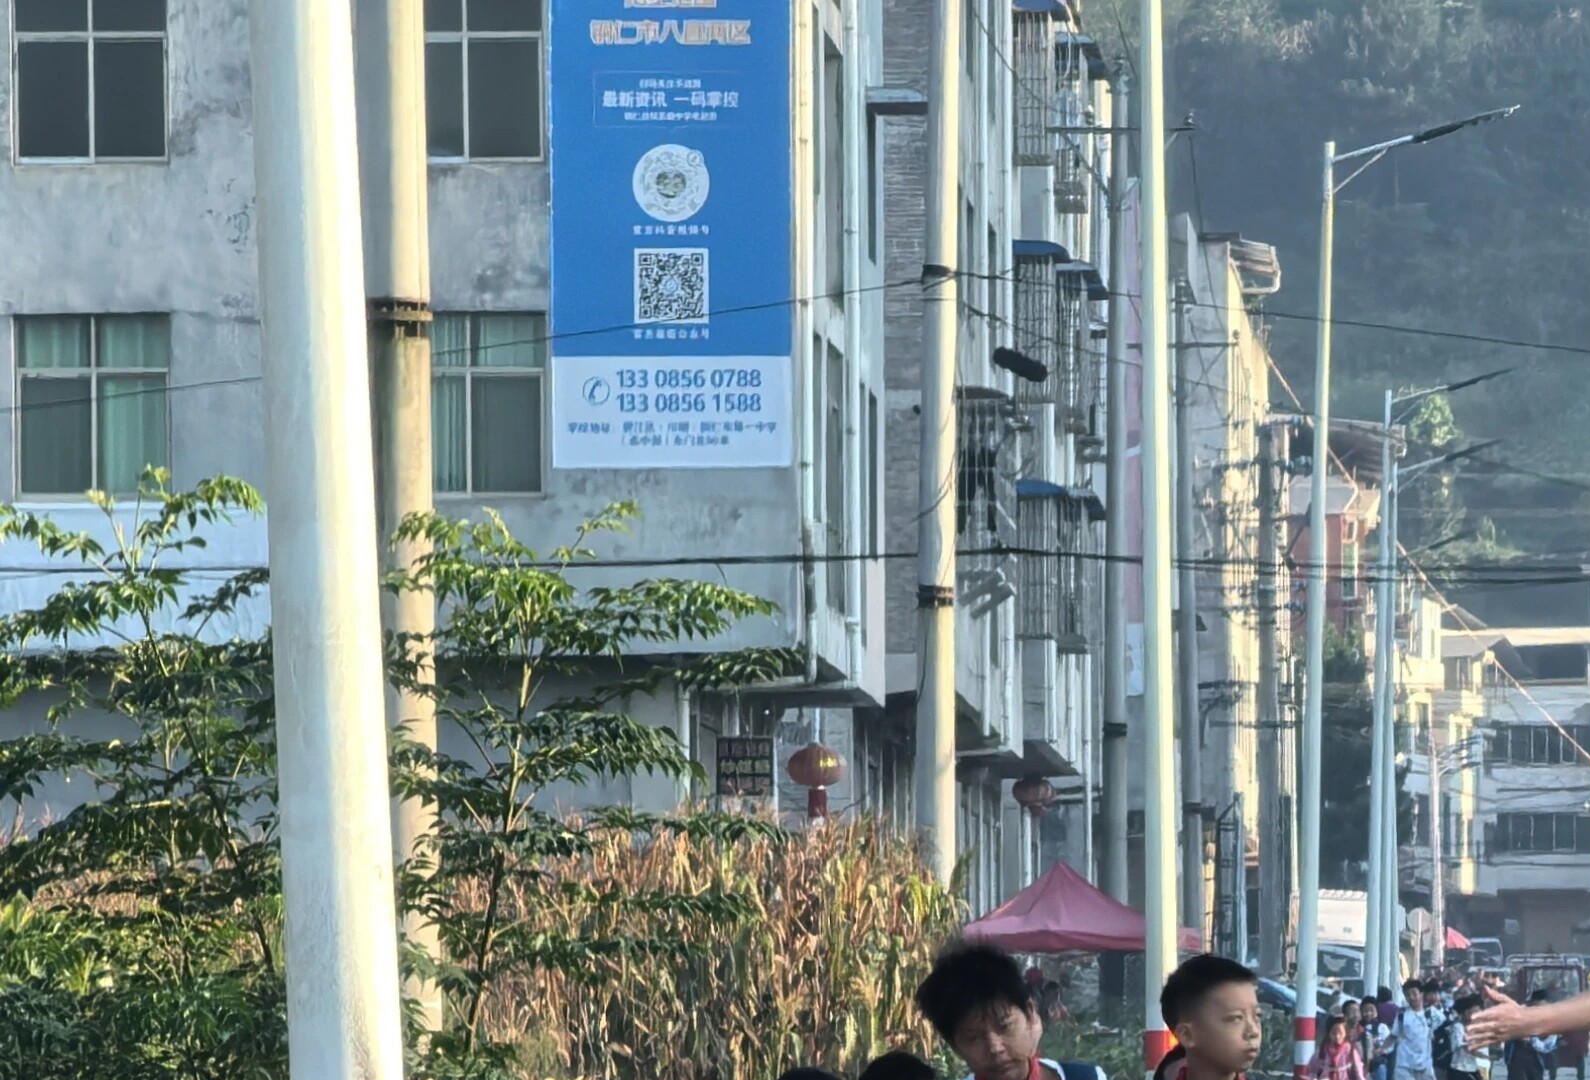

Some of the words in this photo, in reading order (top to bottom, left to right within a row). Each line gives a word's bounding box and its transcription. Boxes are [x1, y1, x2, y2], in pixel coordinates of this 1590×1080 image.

[616, 369, 648, 388] 133
[655, 369, 706, 388] 0856
[710, 369, 761, 388] 0788
[616, 393, 649, 412] 133
[655, 393, 706, 412] 0856
[713, 393, 761, 412] 1588
